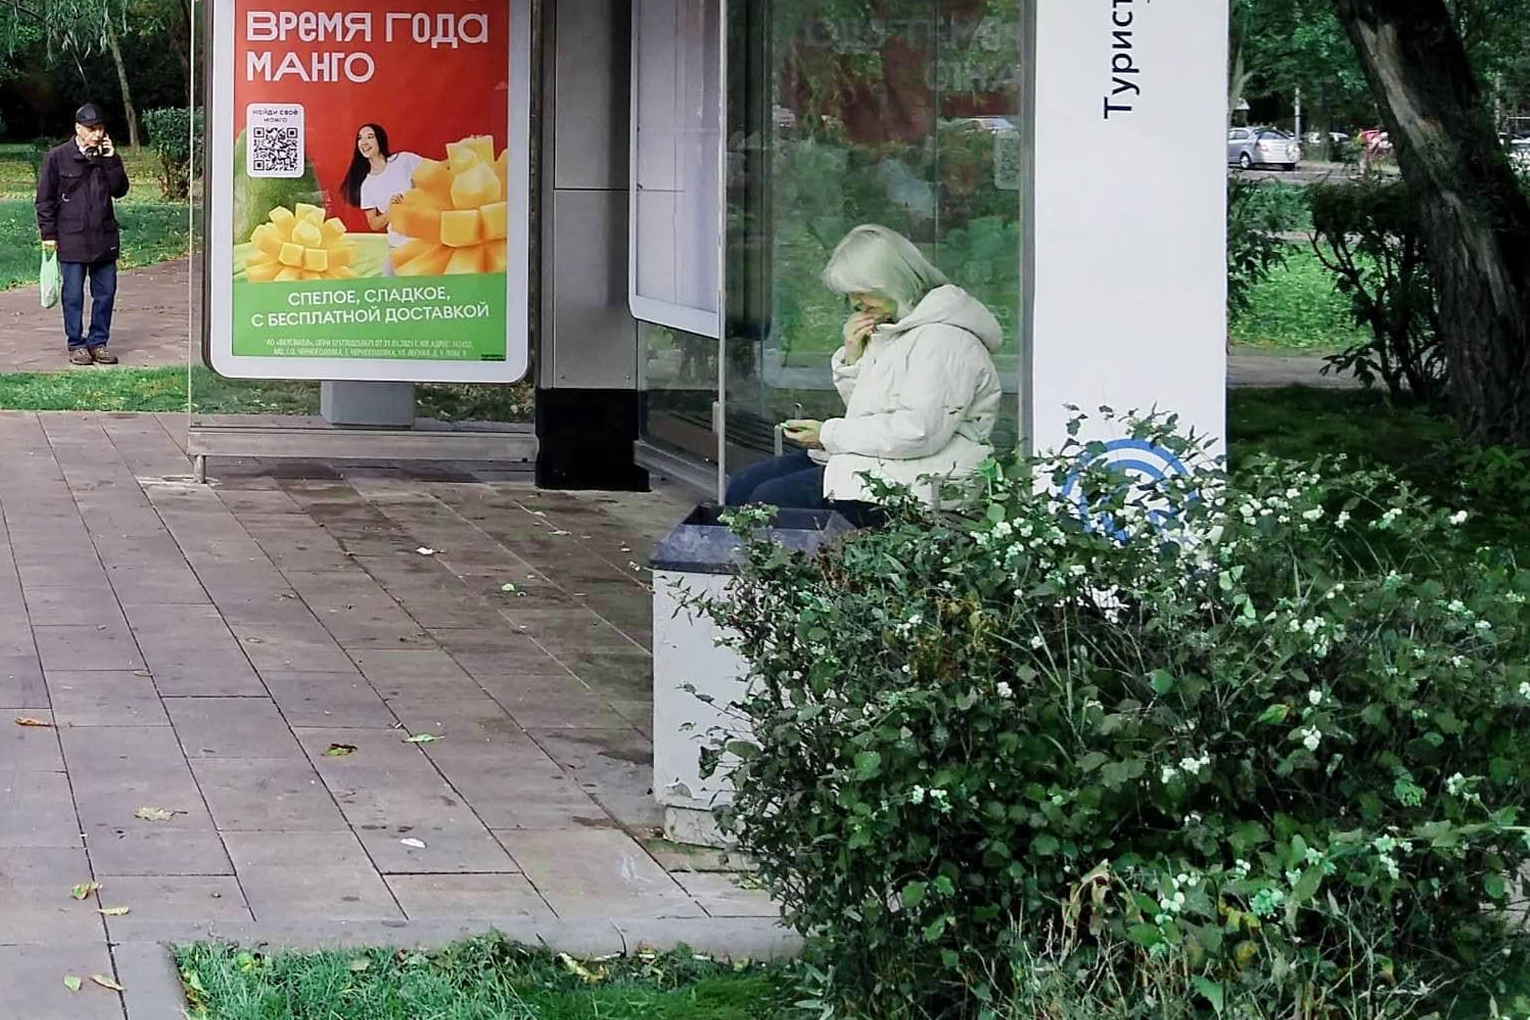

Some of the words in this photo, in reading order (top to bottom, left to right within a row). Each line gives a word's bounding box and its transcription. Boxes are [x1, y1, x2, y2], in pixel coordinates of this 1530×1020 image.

[246, 51, 376, 83] МАНГО
[287, 289, 361, 308] СПЕЛОЕ,
[364, 285, 451, 304] СЛАДКОЕ,
[251, 312, 264, 328] С
[268, 304, 380, 327] БЕСПЛАТНОЙ
[385, 300, 489, 323] ДОСТАВКОЙ
